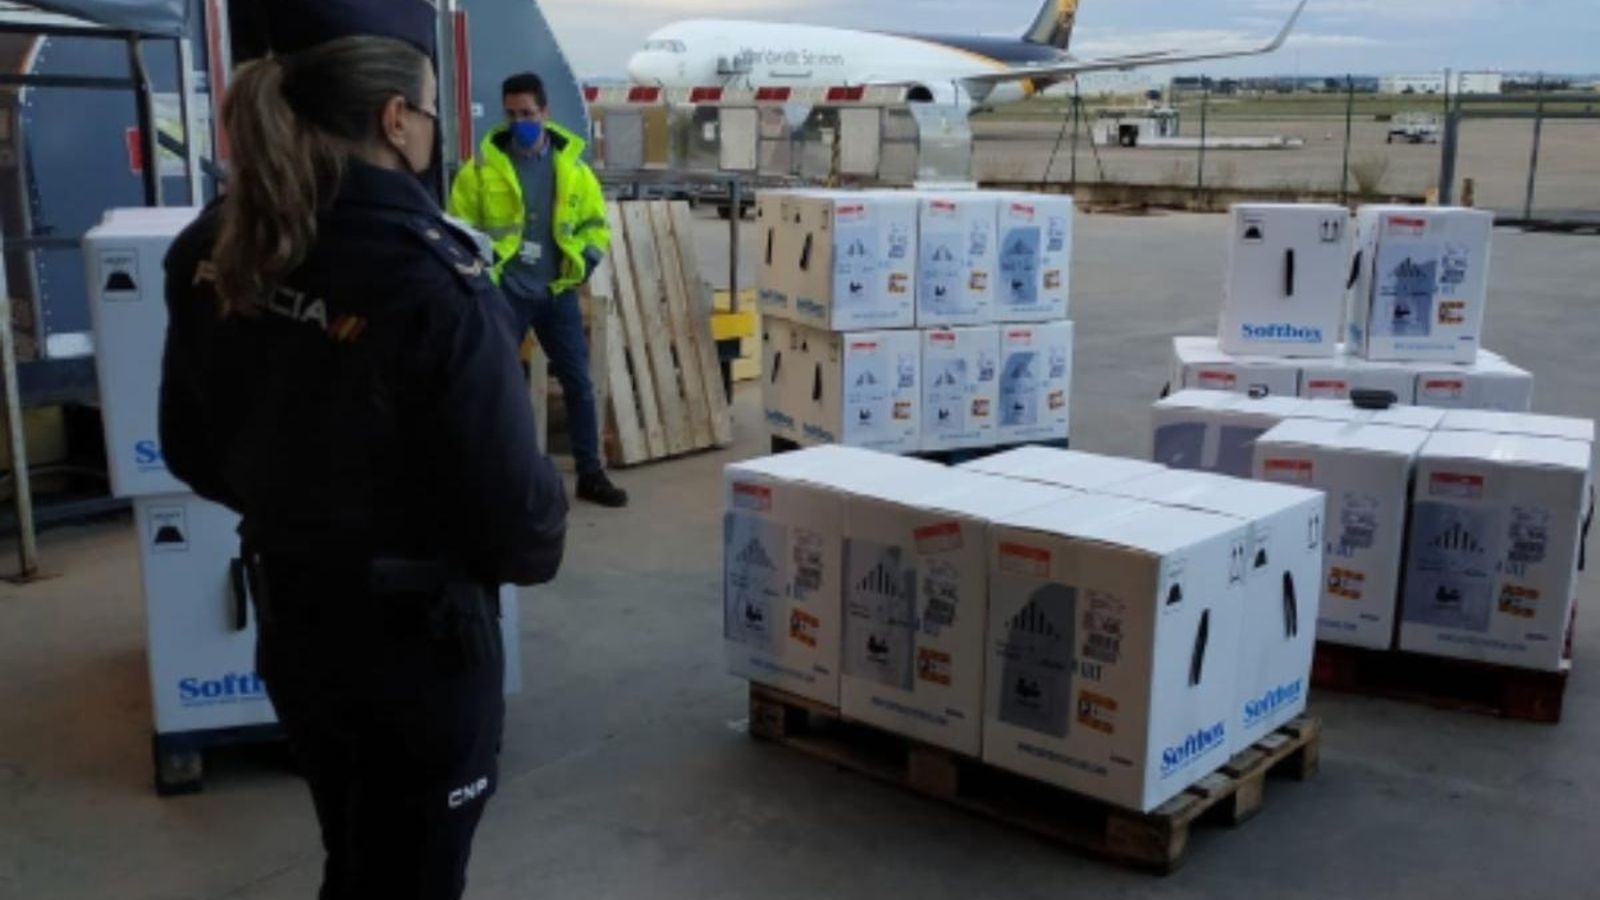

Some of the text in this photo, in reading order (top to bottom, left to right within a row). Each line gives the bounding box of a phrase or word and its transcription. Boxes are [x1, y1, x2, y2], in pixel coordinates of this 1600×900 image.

[192, 261, 328, 330] PCIA
[1241, 323, 1322, 339] Softbox
[179, 672, 260, 698] Soft
[1244, 678, 1302, 720] Softbox
[1161, 721, 1225, 768] Softbox
[448, 777, 487, 807] CNP
